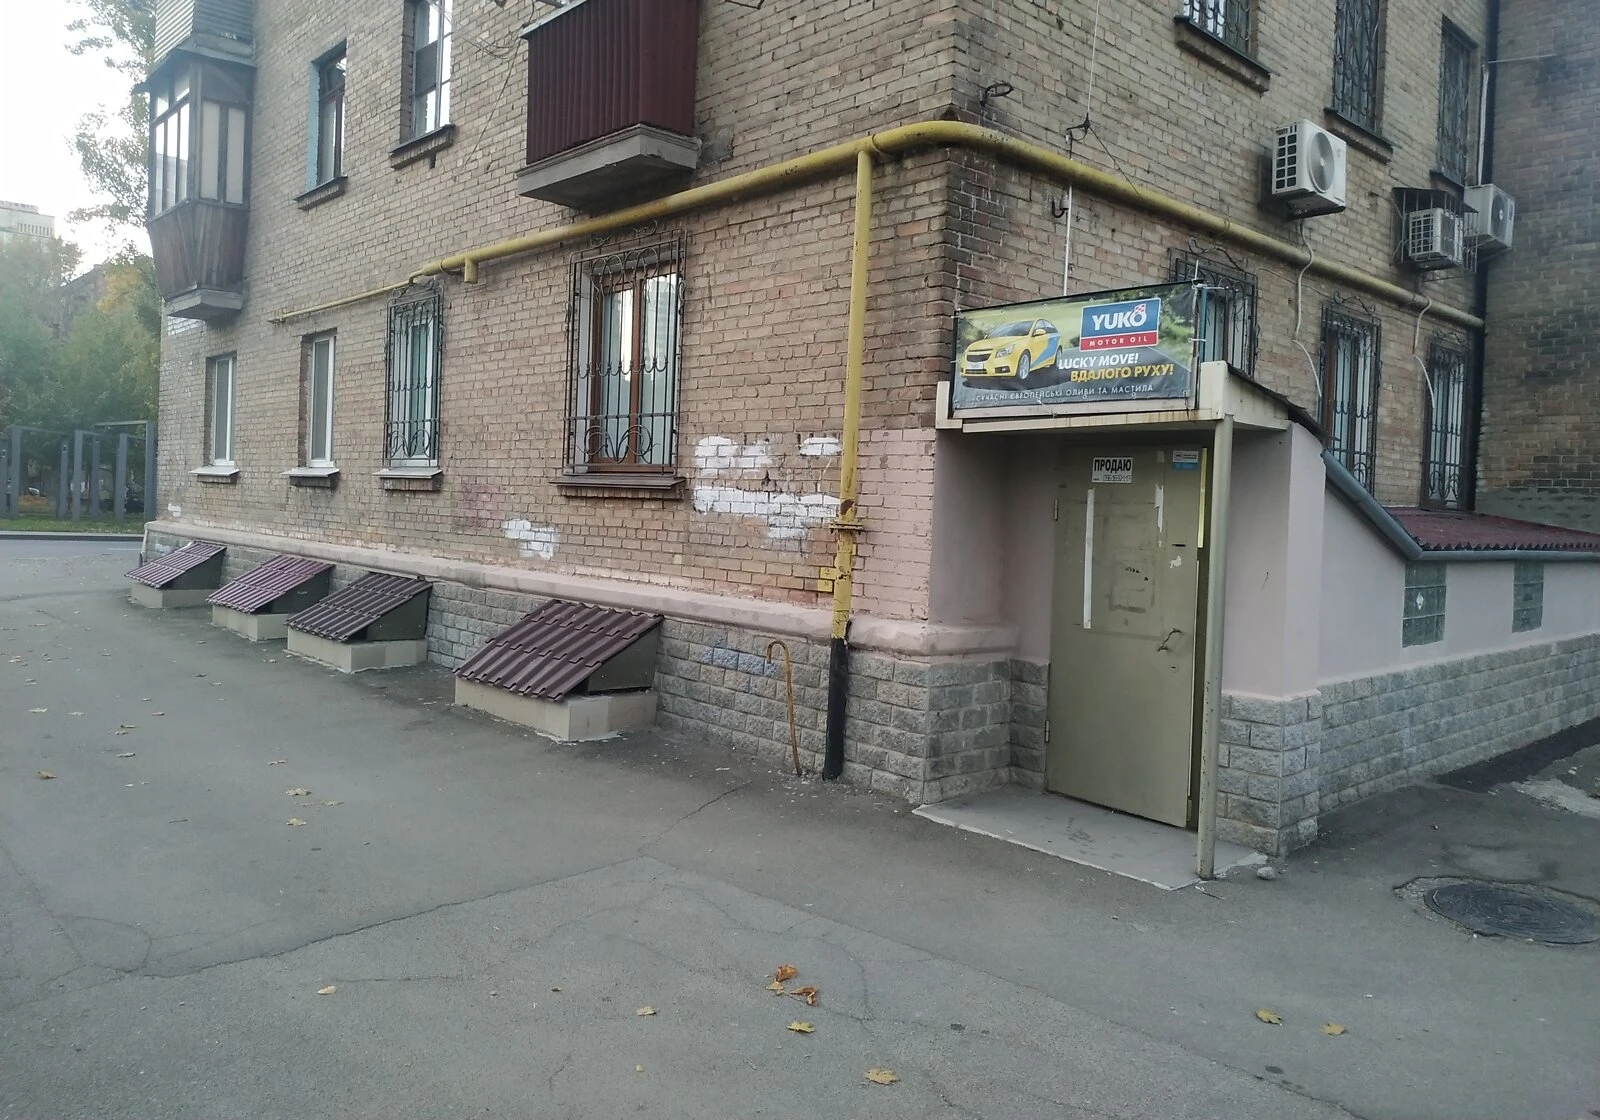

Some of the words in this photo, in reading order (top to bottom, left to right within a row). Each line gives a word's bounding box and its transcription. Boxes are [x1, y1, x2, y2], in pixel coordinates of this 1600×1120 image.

[1092, 305, 1147, 330] YUKO
[1089, 338, 1124, 347] MOTOR
[1058, 356, 1096, 369] LUCKY
[1098, 353, 1139, 366] MOVE!
[1070, 367, 1132, 382] ВДАЛОГО
[1134, 364, 1174, 377] РУХУ!
[976, 394, 1007, 402] СУЧАСНІ
[1010, 390, 1063, 399] ЄВРОПЕЙСЬКІ
[1065, 388, 1095, 396] ОЛИВИ
[1111, 385, 1153, 393] МАСТИЛА
[1094, 459, 1131, 473] ПРОДАЮ
